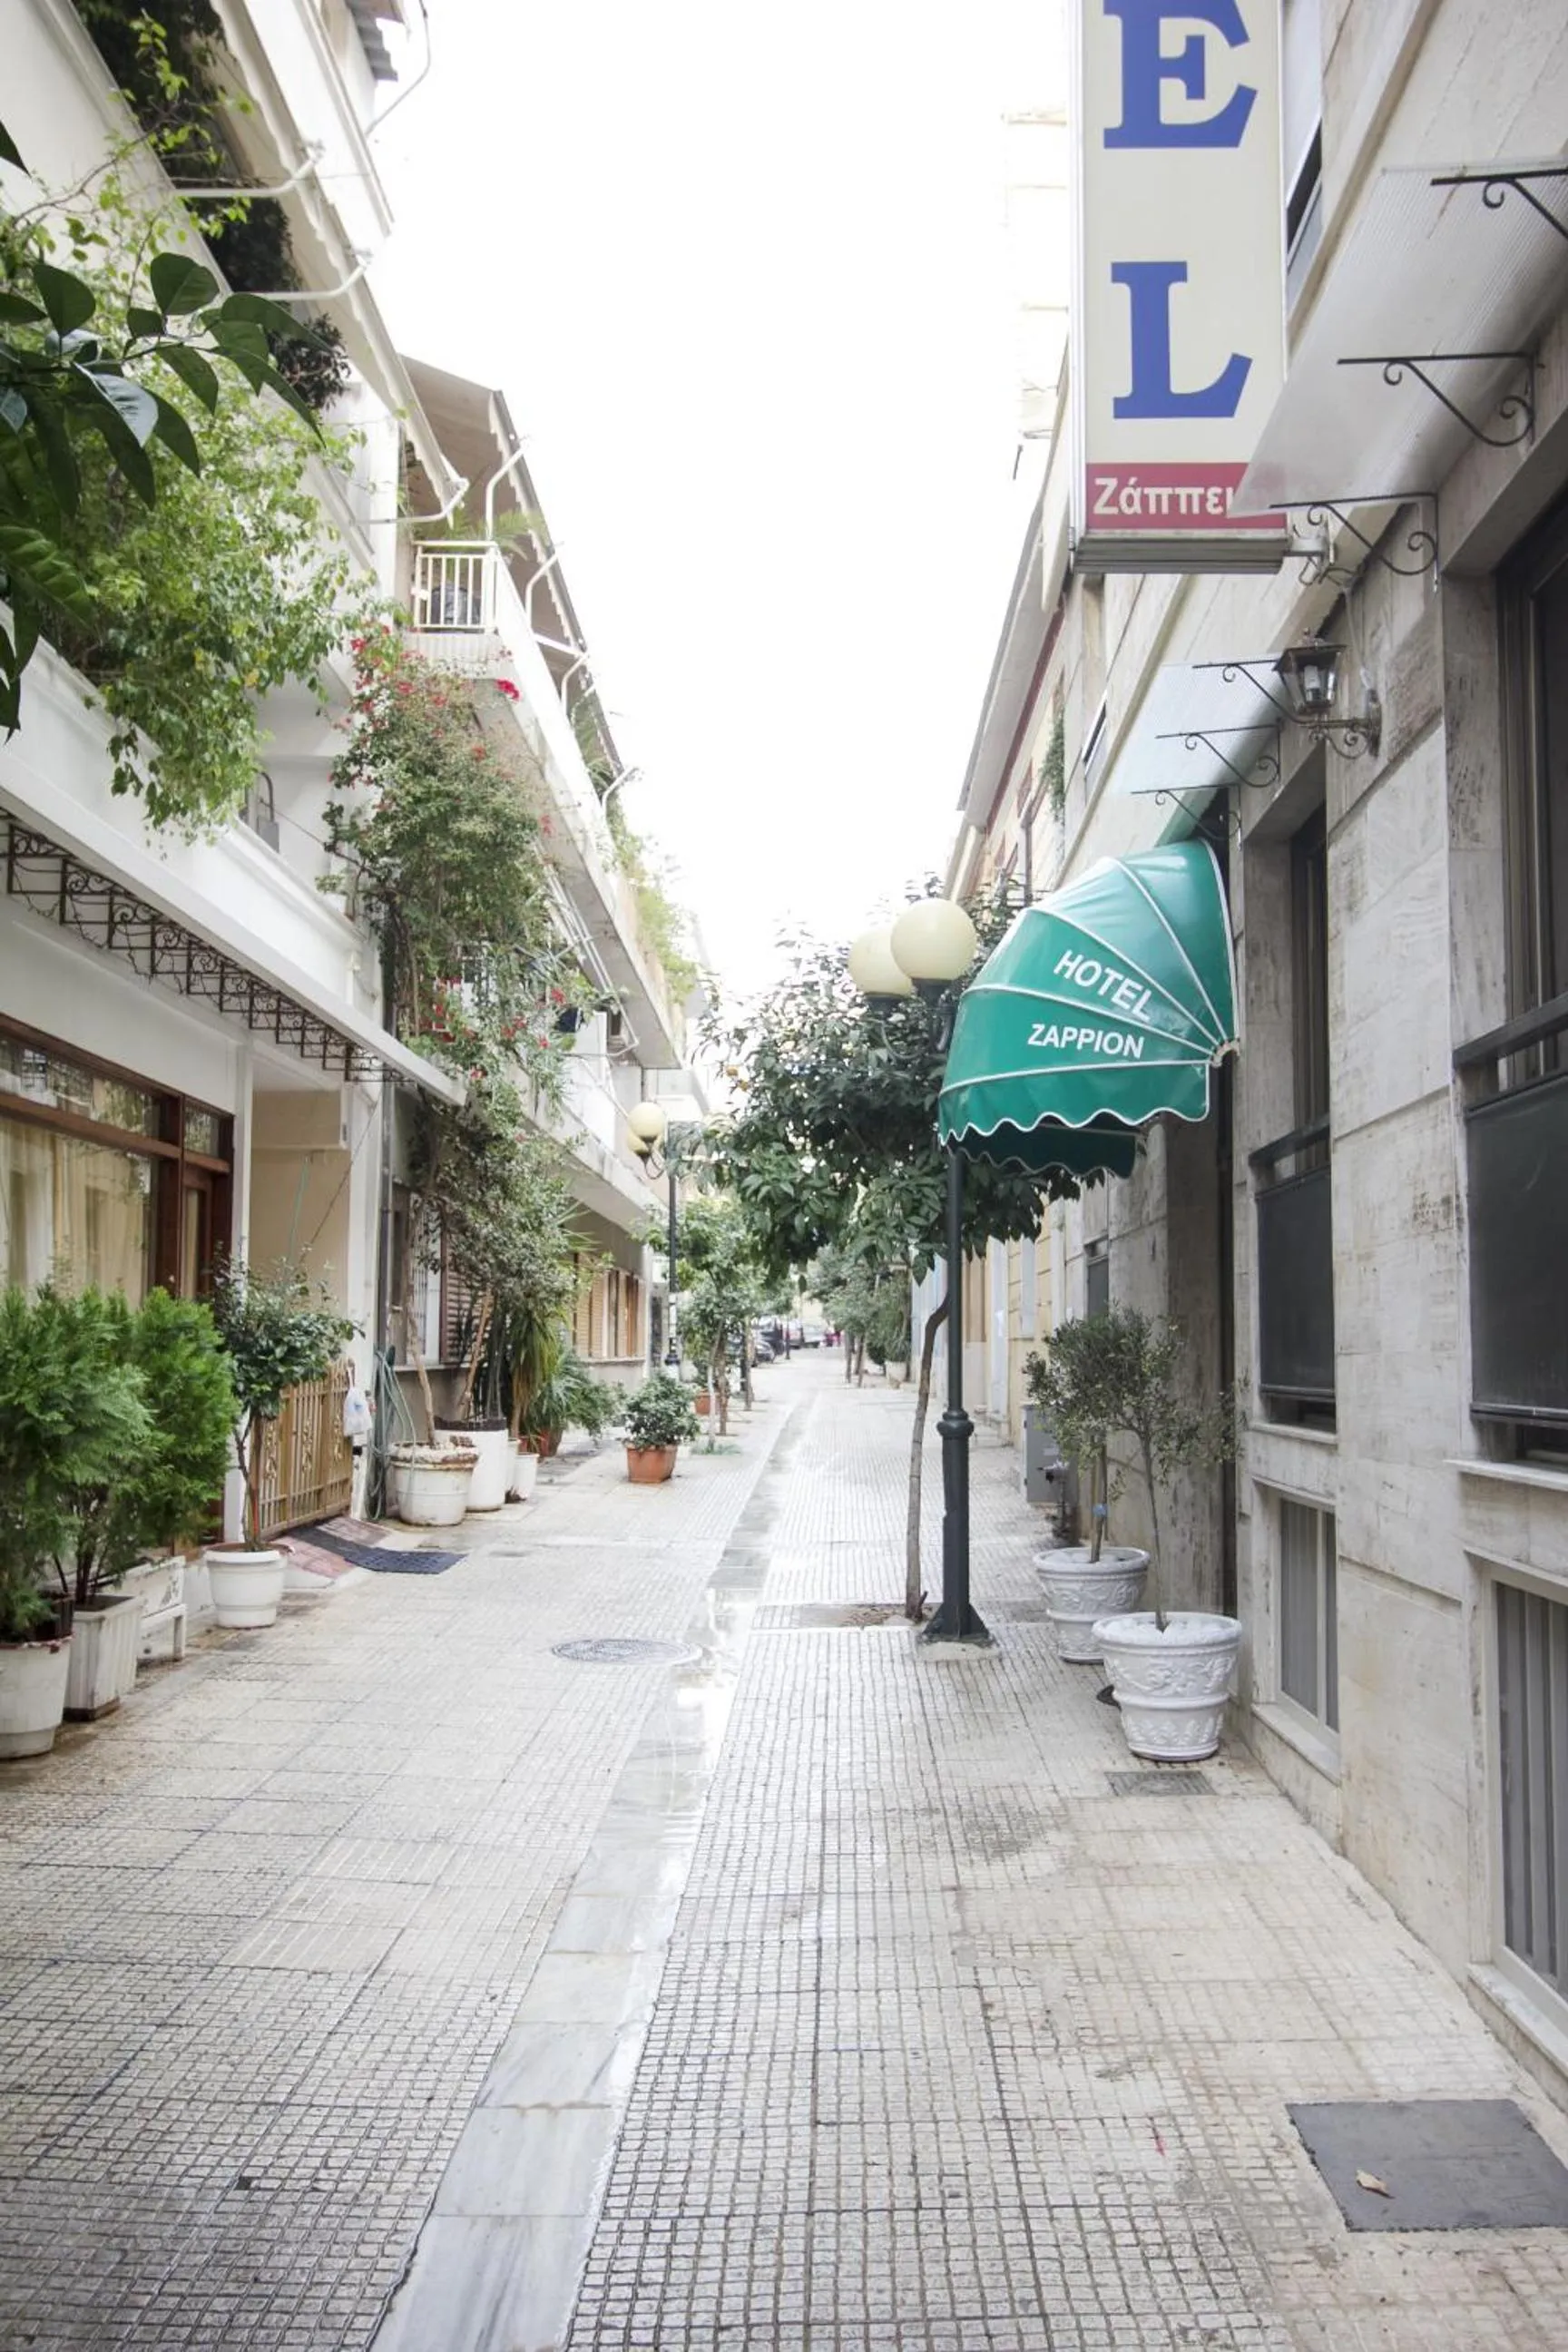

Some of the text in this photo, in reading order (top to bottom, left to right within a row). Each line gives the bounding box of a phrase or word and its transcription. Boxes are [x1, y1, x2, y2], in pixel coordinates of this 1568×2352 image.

[1093, 477, 1235, 515] Ζάππει
[1054, 950, 1152, 1021] HOTEL
[1028, 1024, 1144, 1059] ZAPPION
